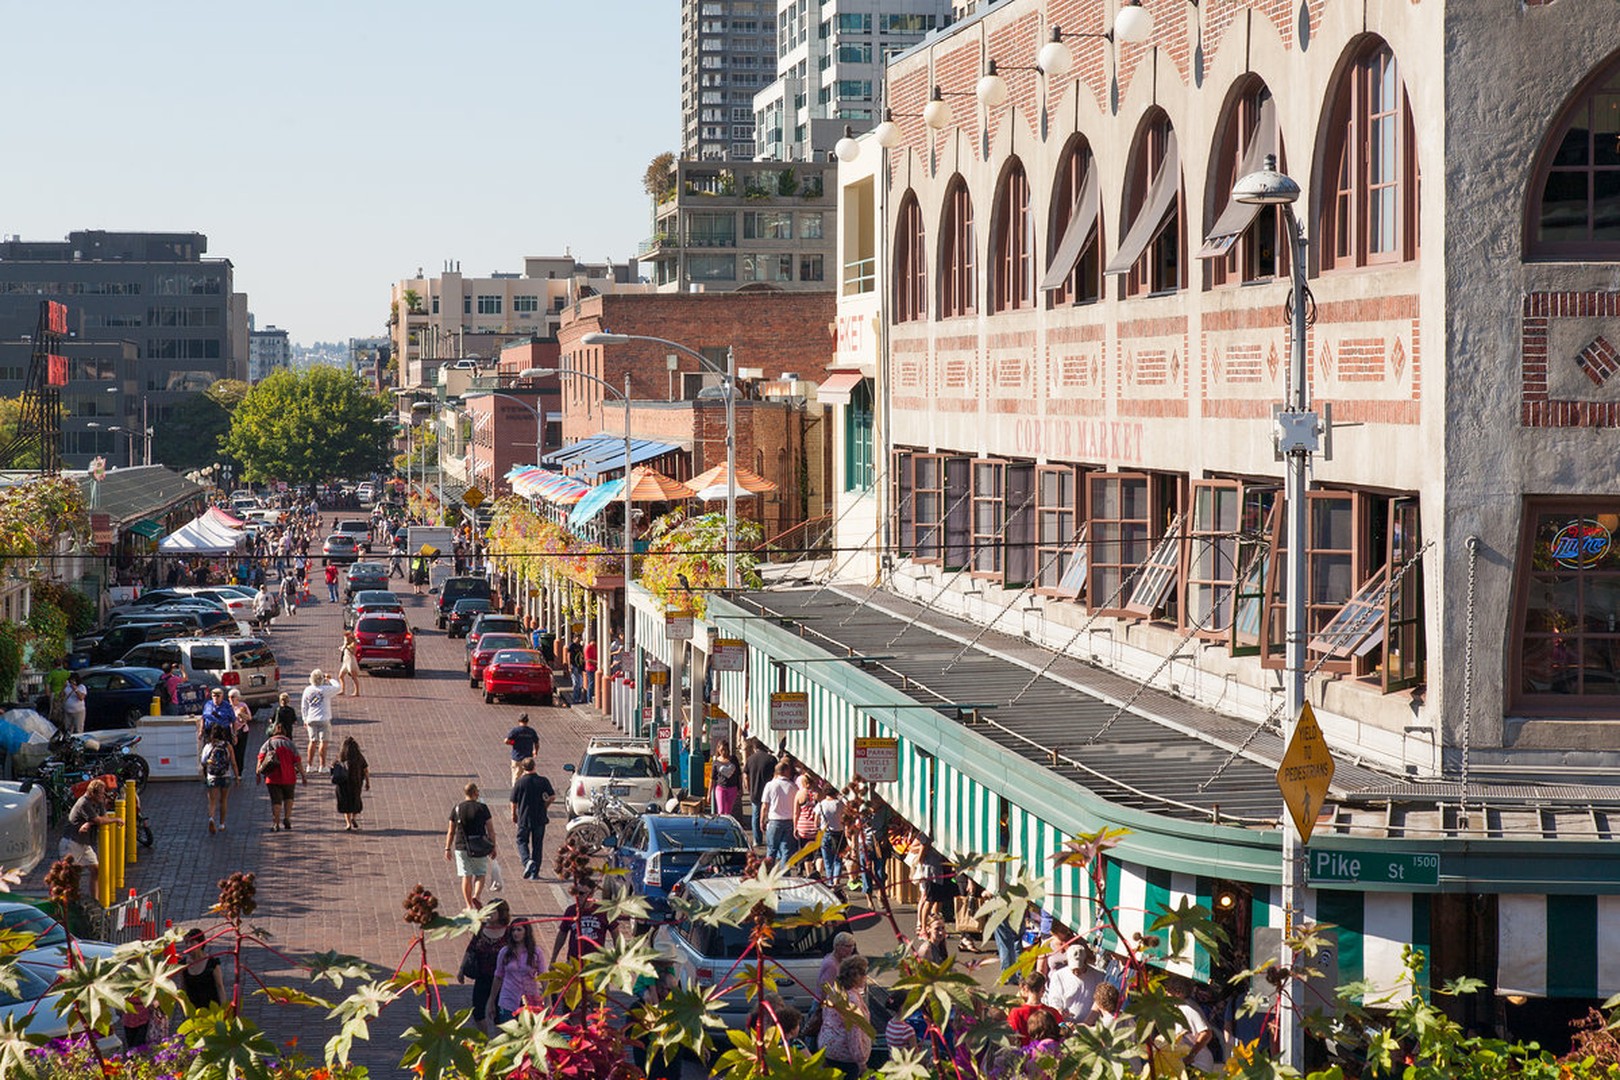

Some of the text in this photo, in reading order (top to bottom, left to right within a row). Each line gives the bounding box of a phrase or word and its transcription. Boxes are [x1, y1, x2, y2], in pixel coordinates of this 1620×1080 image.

[1077, 420, 1144, 462] MARKET
[659, 729, 670, 738] NO
[1299, 724, 1317, 742] YIELD
[868, 749, 896, 757] PARKING
[1303, 745, 1312, 760] TO
[1284, 762, 1329, 782] PEDESTRIANS
[1316, 852, 1438, 880] Pike St 1500
